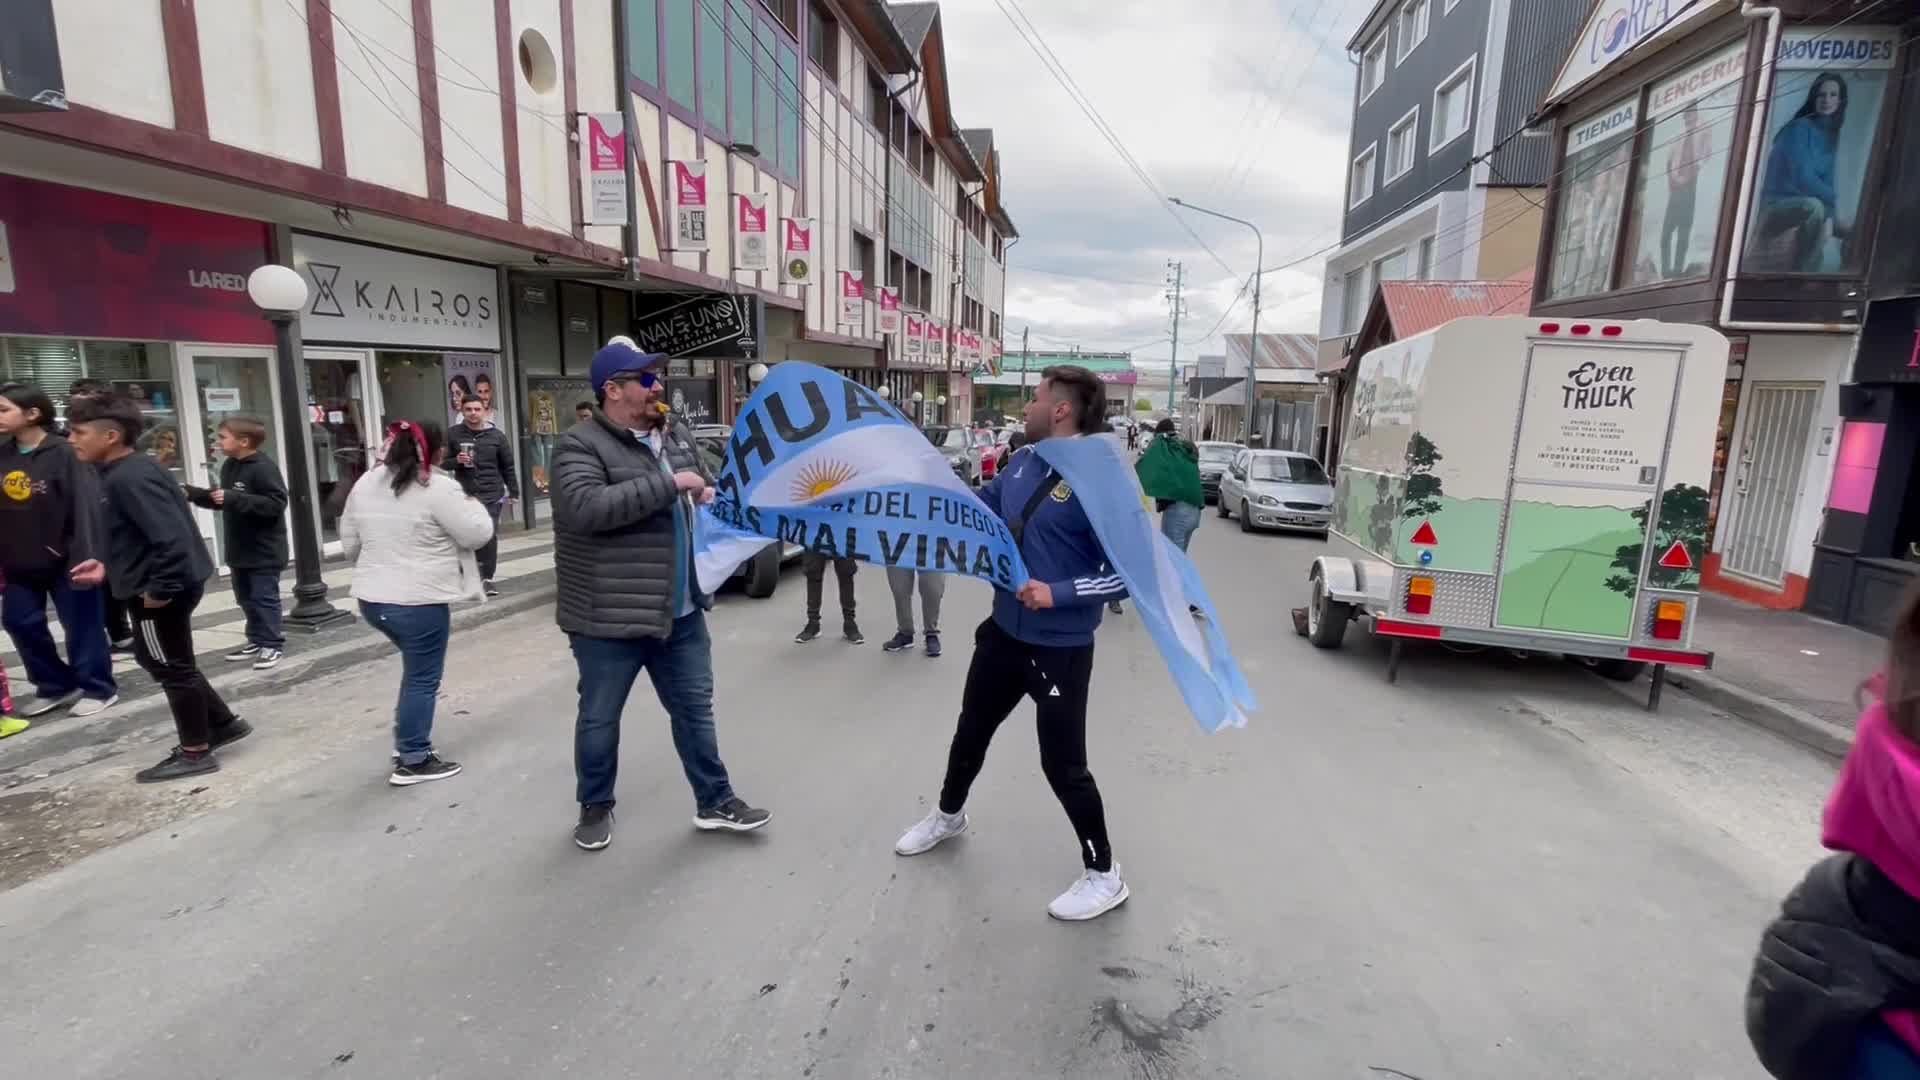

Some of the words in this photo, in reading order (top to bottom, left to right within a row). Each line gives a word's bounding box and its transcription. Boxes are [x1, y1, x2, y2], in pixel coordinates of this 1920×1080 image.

[1779, 39, 1893, 61] NOVEDADES
[1576, 107, 1635, 146] TIENDA
[354, 280, 491, 320] KAIROS
[639, 311, 690, 346] NAVE
[689, 300, 734, 328] UNO
[1568, 361, 1636, 387] Even
[1562, 385, 1637, 409] TRUCK
[864, 491, 917, 519] DEL
[928, 496, 997, 537] FUEGO
[777, 514, 1012, 585] MALVINAS
